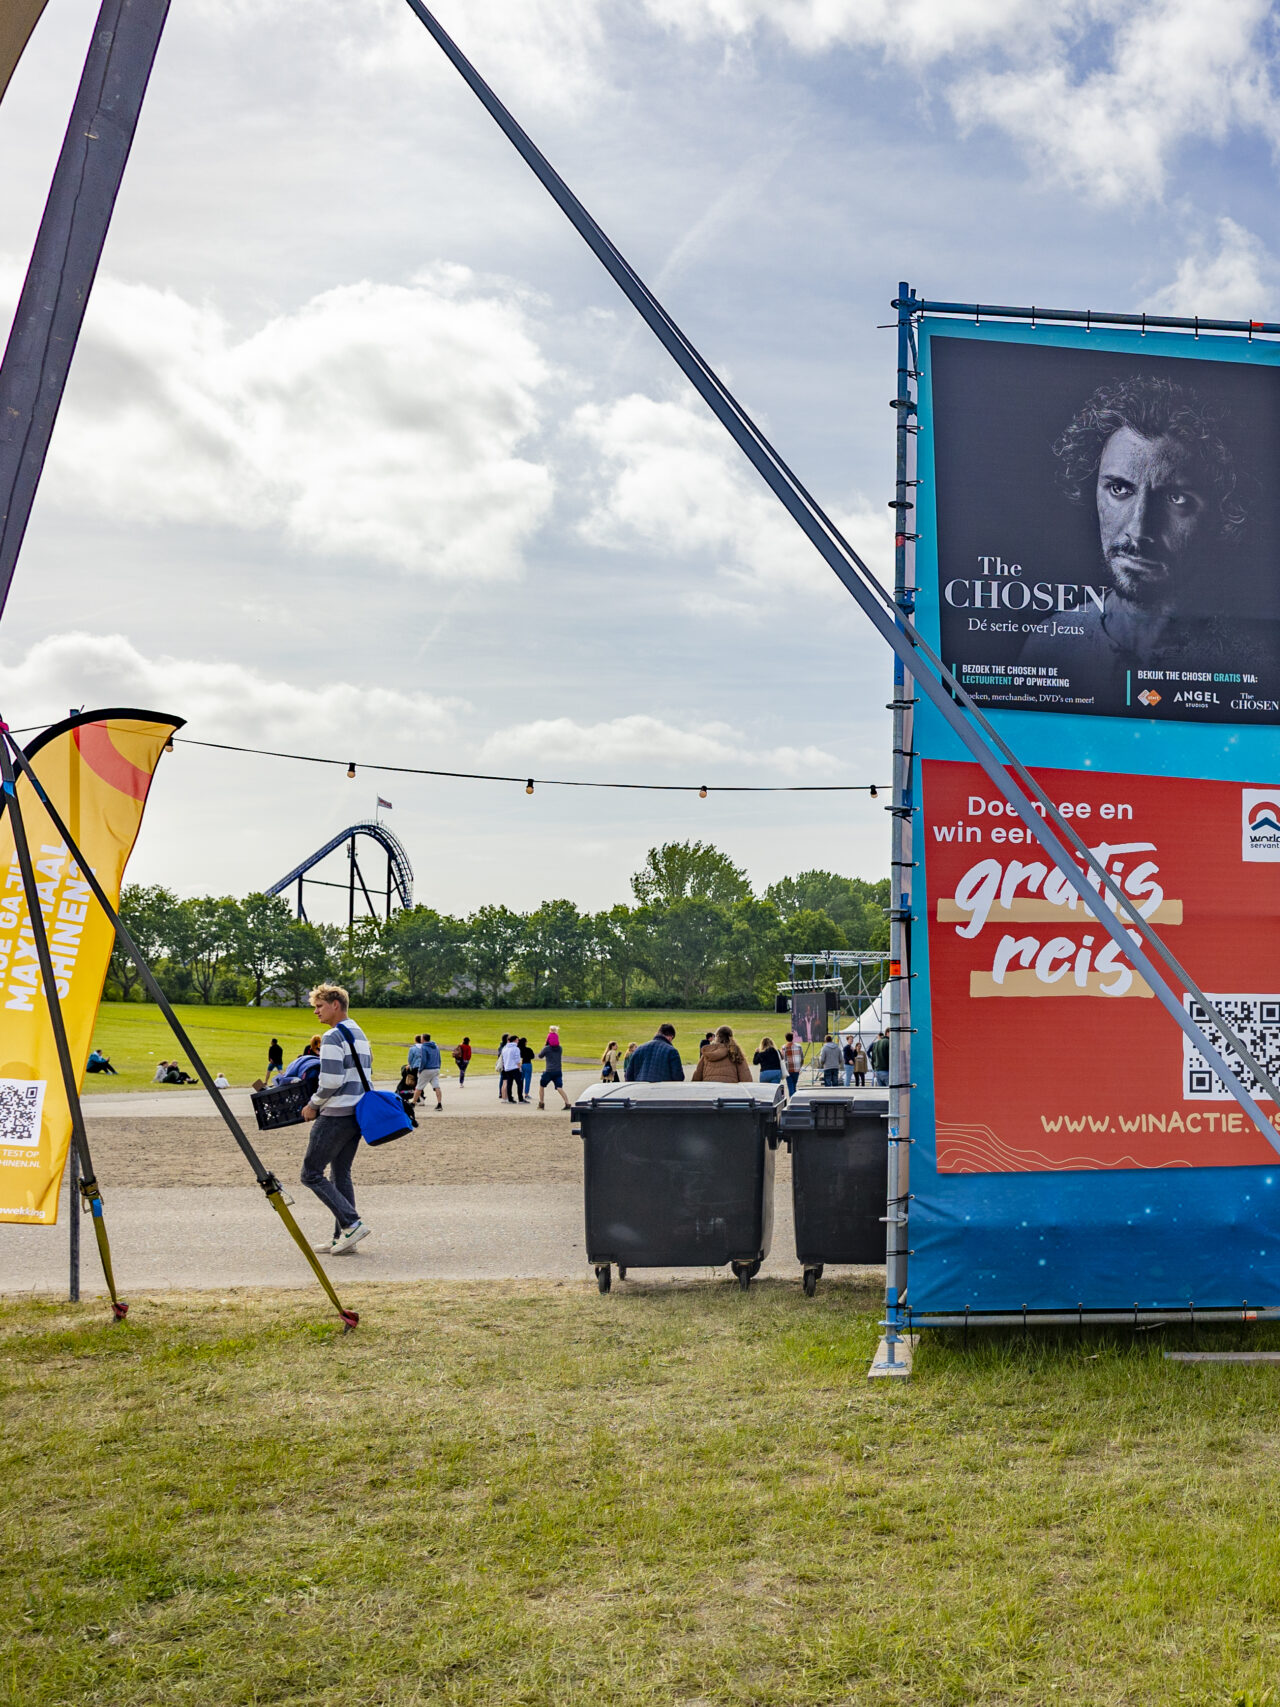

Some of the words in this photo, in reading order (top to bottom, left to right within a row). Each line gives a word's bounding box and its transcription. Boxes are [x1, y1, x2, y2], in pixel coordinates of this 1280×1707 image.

[978, 556, 1022, 576] The
[944, 578, 1107, 613] CHOSEN
[968, 617, 987, 631] Dé
[990, 620, 1018, 632] serie
[1021, 624, 1048, 633] over
[1050, 621, 1084, 636] Jezus
[962, 664, 990, 674] BEZOEK
[991, 665, 1005, 675] THE
[1007, 666, 1036, 676] CHOSEN
[1038, 667, 1046, 676] IN
[1048, 667, 1058, 676] DE
[1137, 670, 1164, 680] BEKIJK
[1165, 671, 1180, 681] THE
[1181, 672, 1212, 682] CHOSEN
[1213, 673, 1241, 683] GRATIS
[1242, 674, 1258, 683] VIA:
[962, 675, 1012, 686] LECTUURTENT
[1013, 676, 1024, 686] OP
[1026, 678, 1070, 688] OPWEKKING
[967, 692, 991, 702] oeken,
[991, 694, 1038, 703] merchandise,
[1173, 690, 1220, 704] ANGEL
[1240, 692, 1254, 700] The
[1230, 700, 1280, 711] CHOSEN
[968, 796, 1018, 816] Doe
[1099, 802, 1133, 819] en
[933, 821, 982, 843] win
[955, 842, 1164, 939] gratis
[992, 929, 1143, 996] reis
